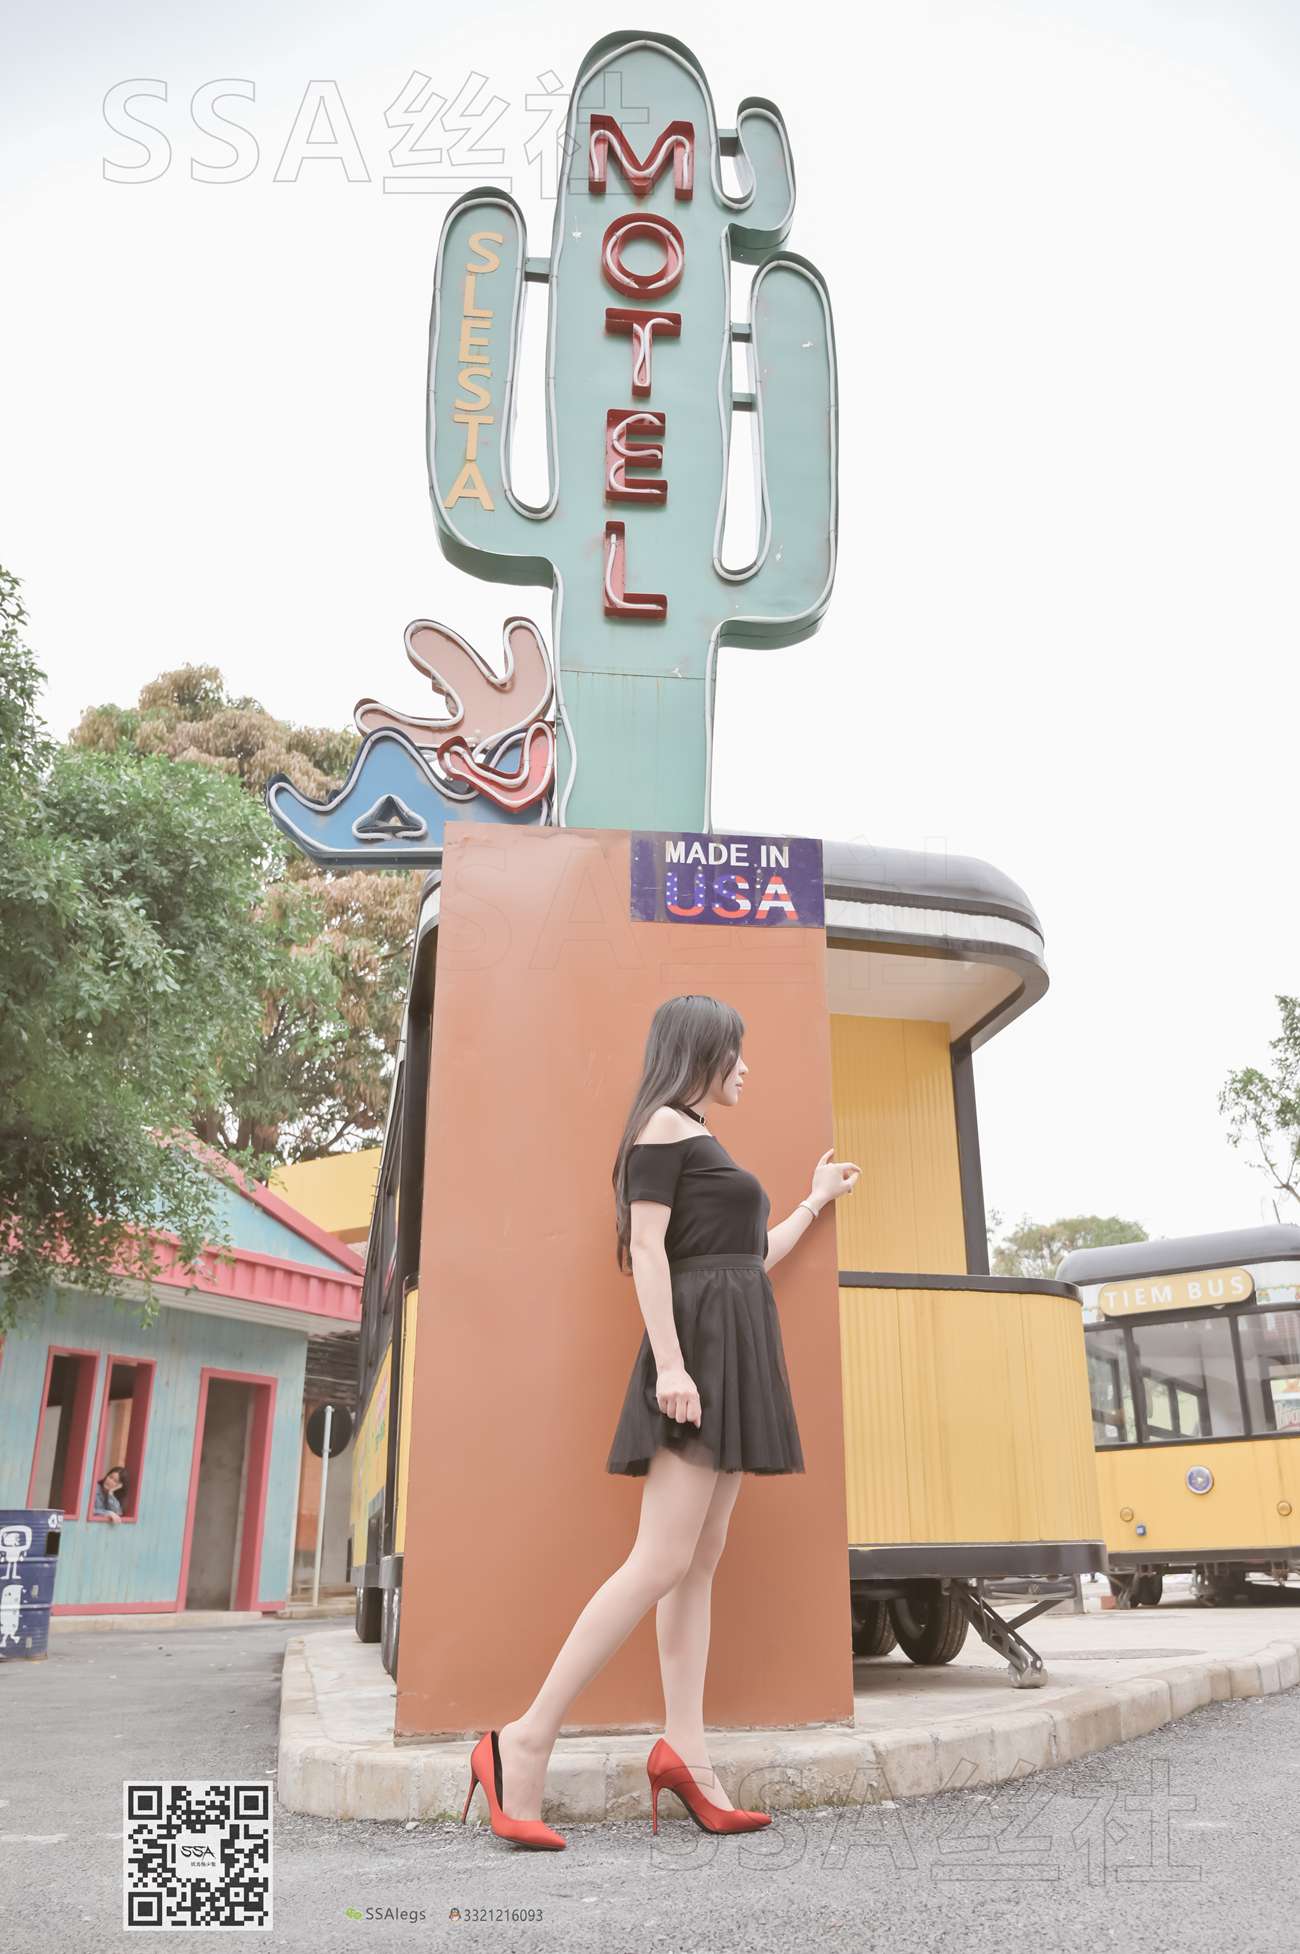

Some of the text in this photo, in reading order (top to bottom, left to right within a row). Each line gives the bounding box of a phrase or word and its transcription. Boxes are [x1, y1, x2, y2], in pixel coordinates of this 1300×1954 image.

[444, 231, 505, 512] SLESTA
[589, 114, 694, 619] MOTEL
[664, 840, 790, 869] MADE IN
[665, 871, 798, 920] USA
[1102, 1276, 1244, 1309] TIEM BUS
